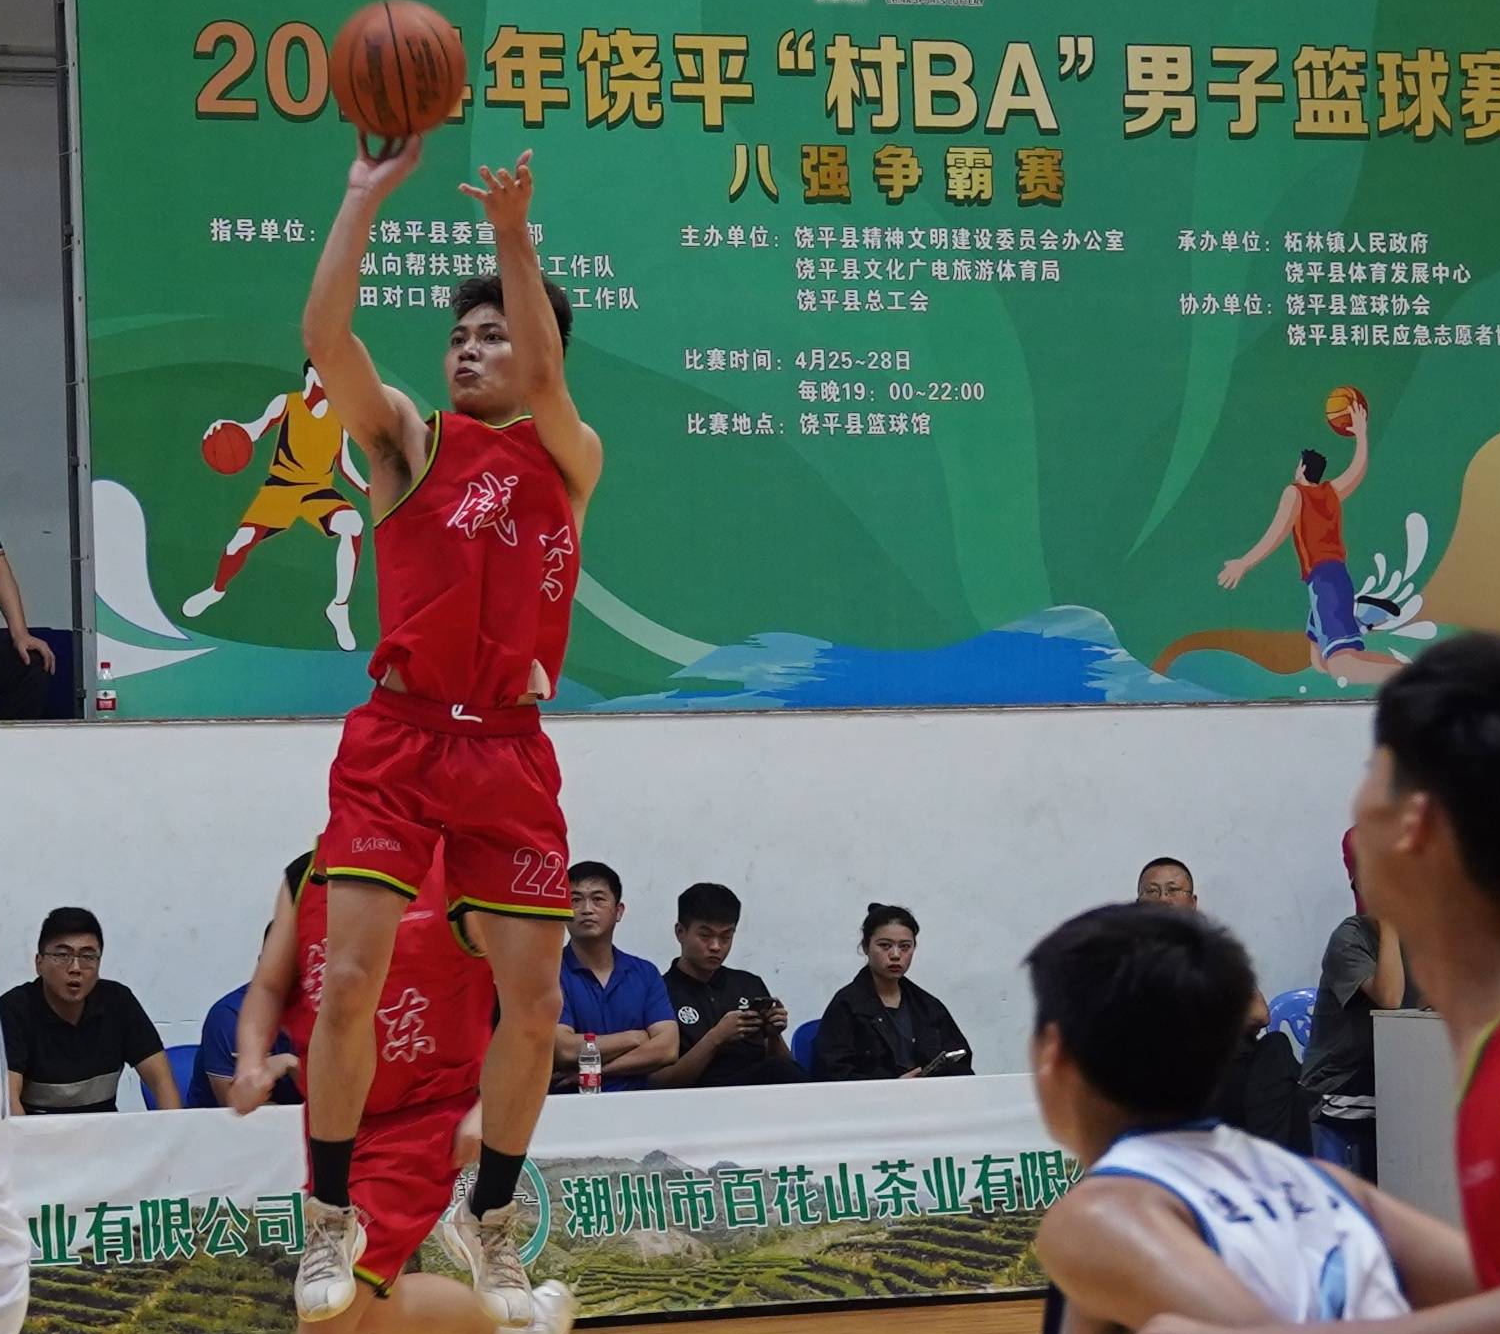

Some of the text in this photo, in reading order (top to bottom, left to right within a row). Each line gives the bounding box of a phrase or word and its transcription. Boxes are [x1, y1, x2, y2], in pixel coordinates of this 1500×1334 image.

[729, 143, 1068, 208] 八强争霸赛
[795, 257, 1061, 283] 饶平县文化广电旅游体育局
[1285, 262, 1472, 285] 饶平县体育发展中心
[797, 289, 930, 313] 饶平县总工会
[510, 845, 568, 900] 22
[563, 1149, 1088, 1240] 潮州市百花山茶业有限
